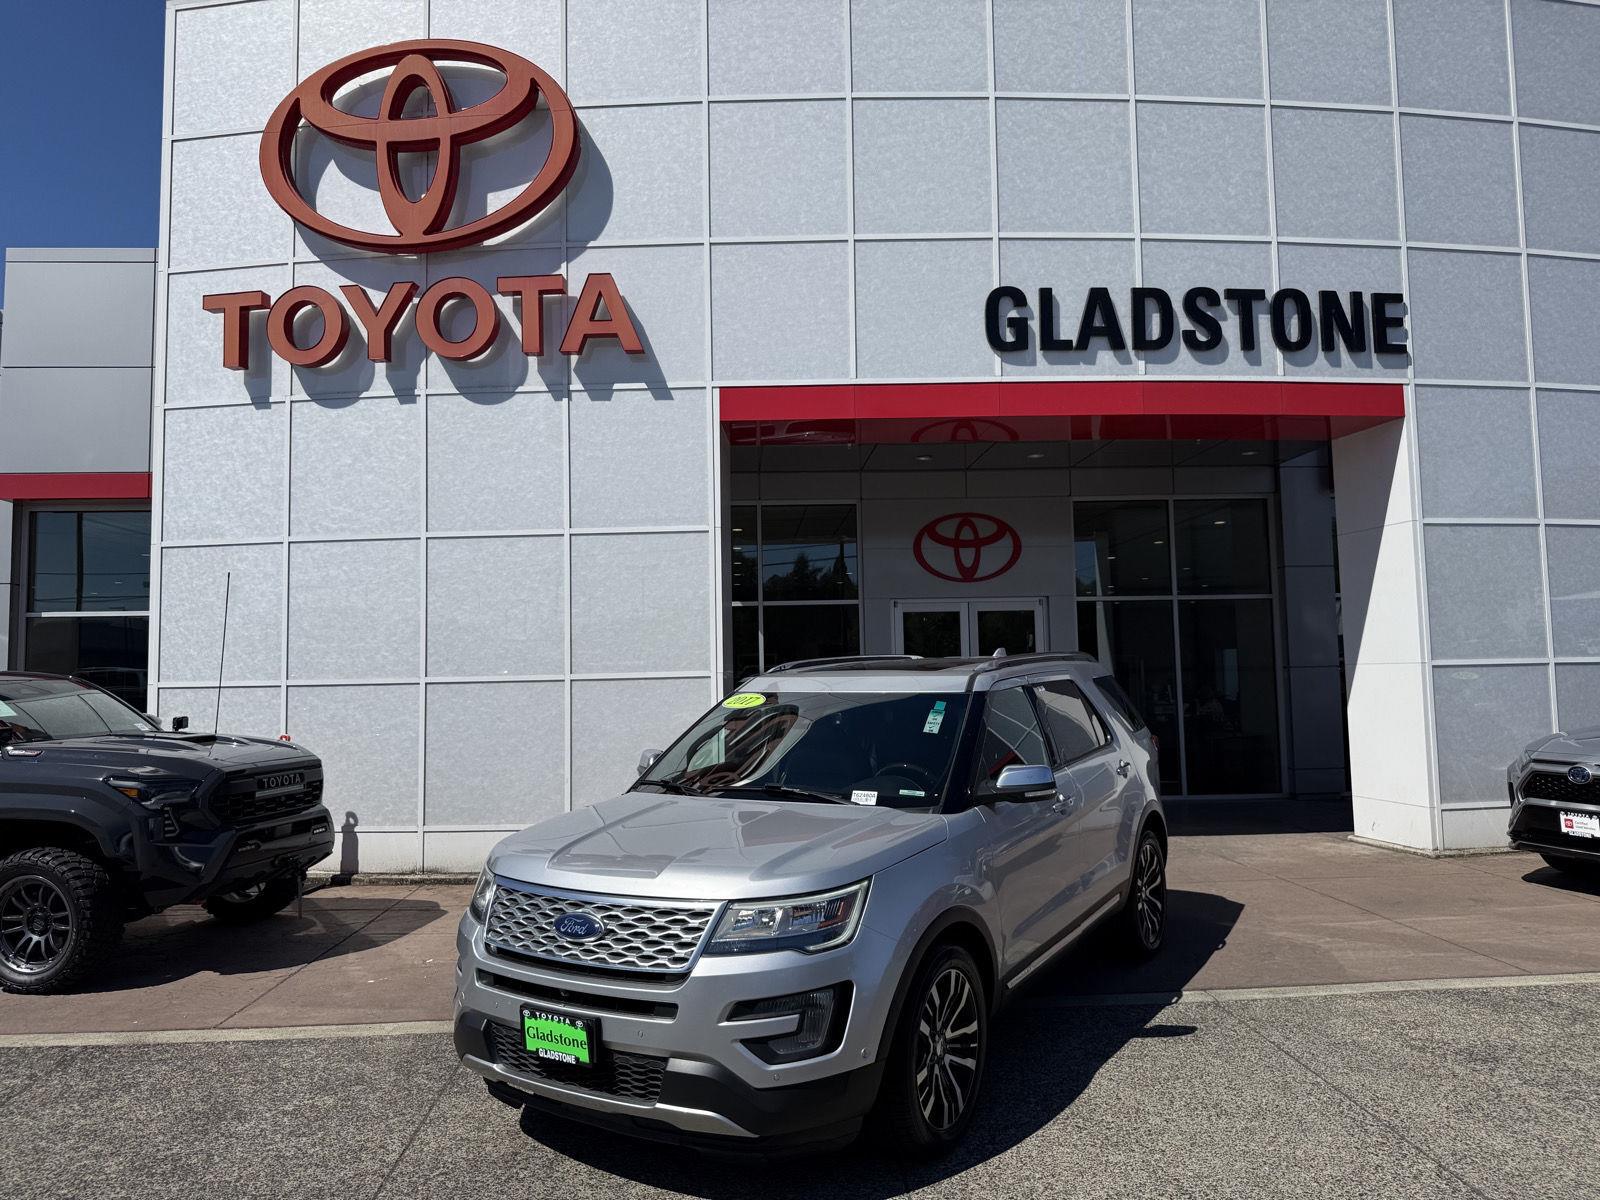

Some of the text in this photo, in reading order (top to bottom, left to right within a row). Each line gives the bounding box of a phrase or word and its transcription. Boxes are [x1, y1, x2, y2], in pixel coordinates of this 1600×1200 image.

[203, 273, 645, 370] TOYOTA
[985, 286, 1408, 354] GLADSTONE
[726, 696, 761, 706] 2017
[263, 774, 301, 789] TOYOTA
[560, 917, 588, 934] Ford
[535, 1012, 571, 1024] TOYOTA
[526, 1026, 587, 1049] Gladstone
[538, 1048, 576, 1064] GLADSTONE
